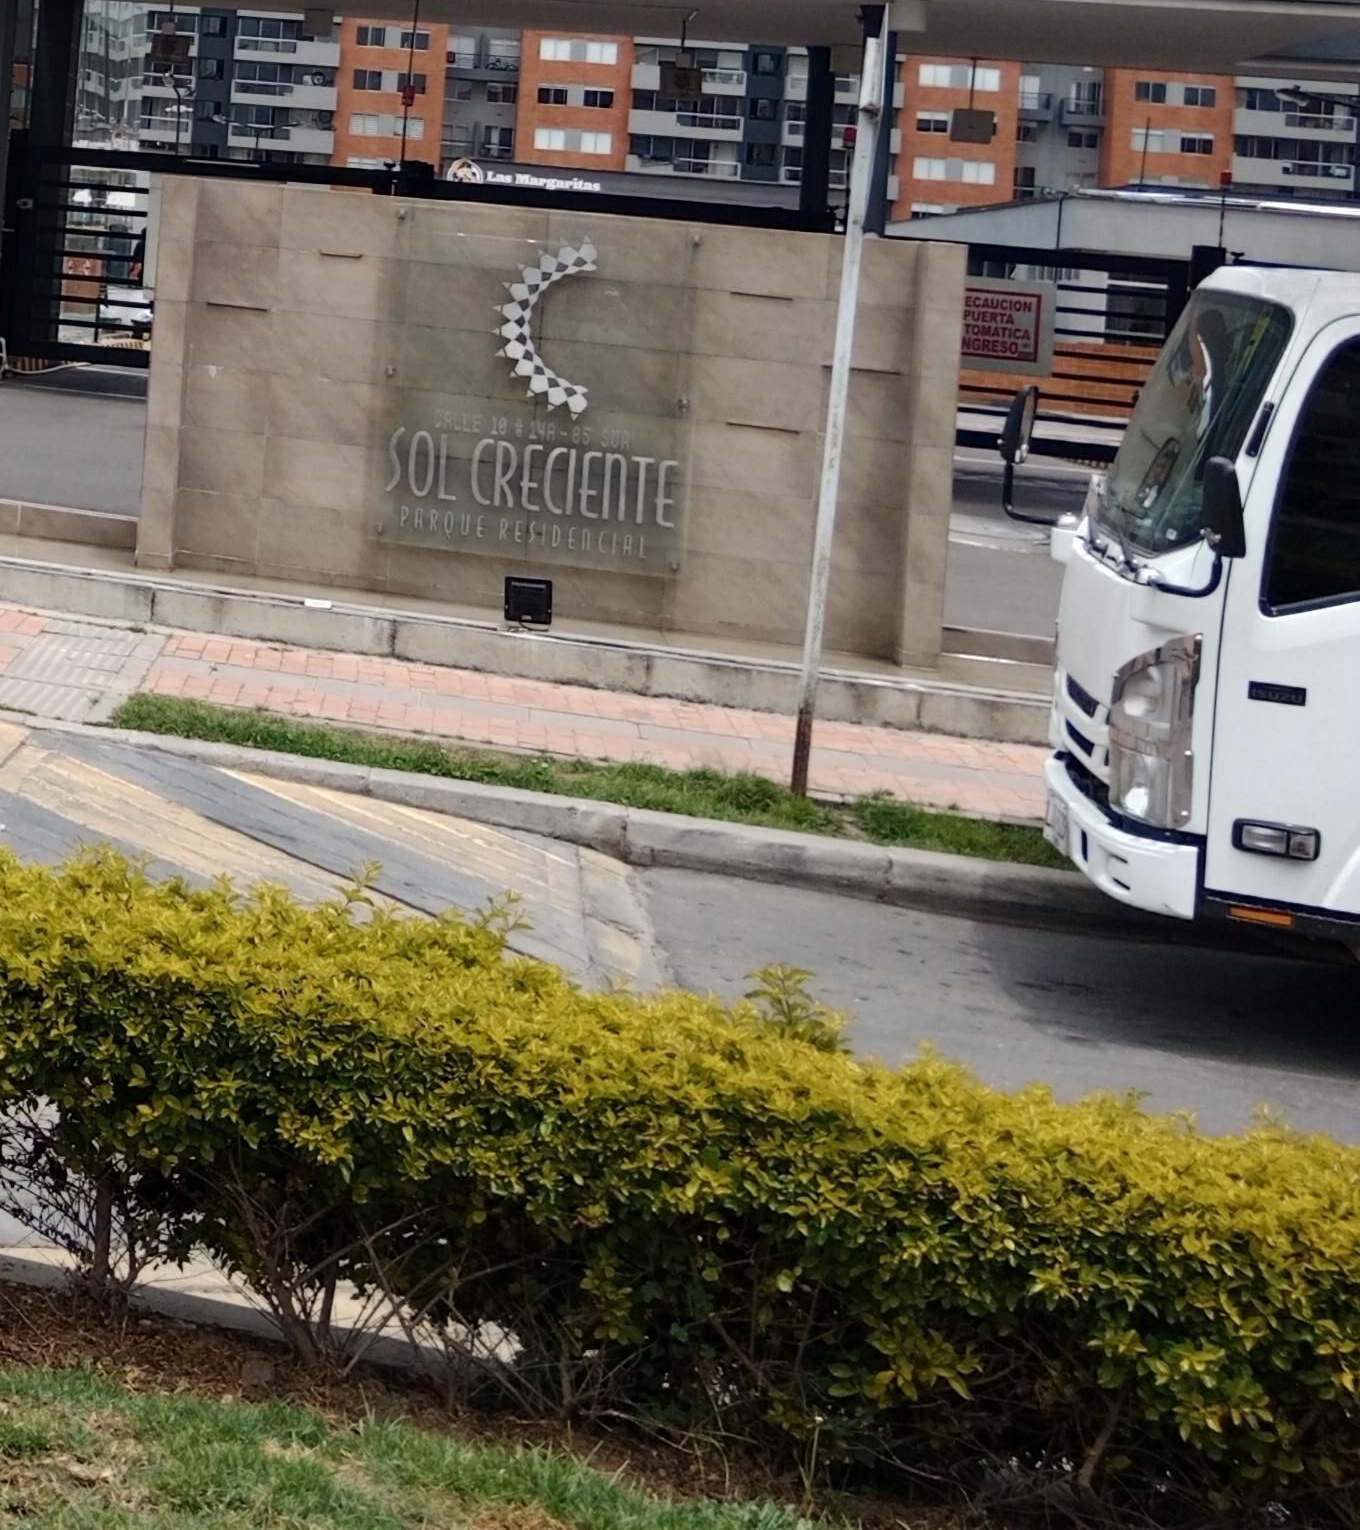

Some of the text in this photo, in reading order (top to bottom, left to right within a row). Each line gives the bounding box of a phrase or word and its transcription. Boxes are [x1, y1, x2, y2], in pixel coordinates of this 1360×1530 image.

[487, 171, 601, 191] Las Margaritas
[964, 310, 1014, 325] PUERTA
[964, 324, 1030, 341] TOMATICA
[434, 411, 480, 433] CALLE
[600, 429, 630, 450] SUR
[385, 427, 679, 528] SOL CRECIENTE
[400, 505, 646, 559] PARQUE RESIDENCIAL
